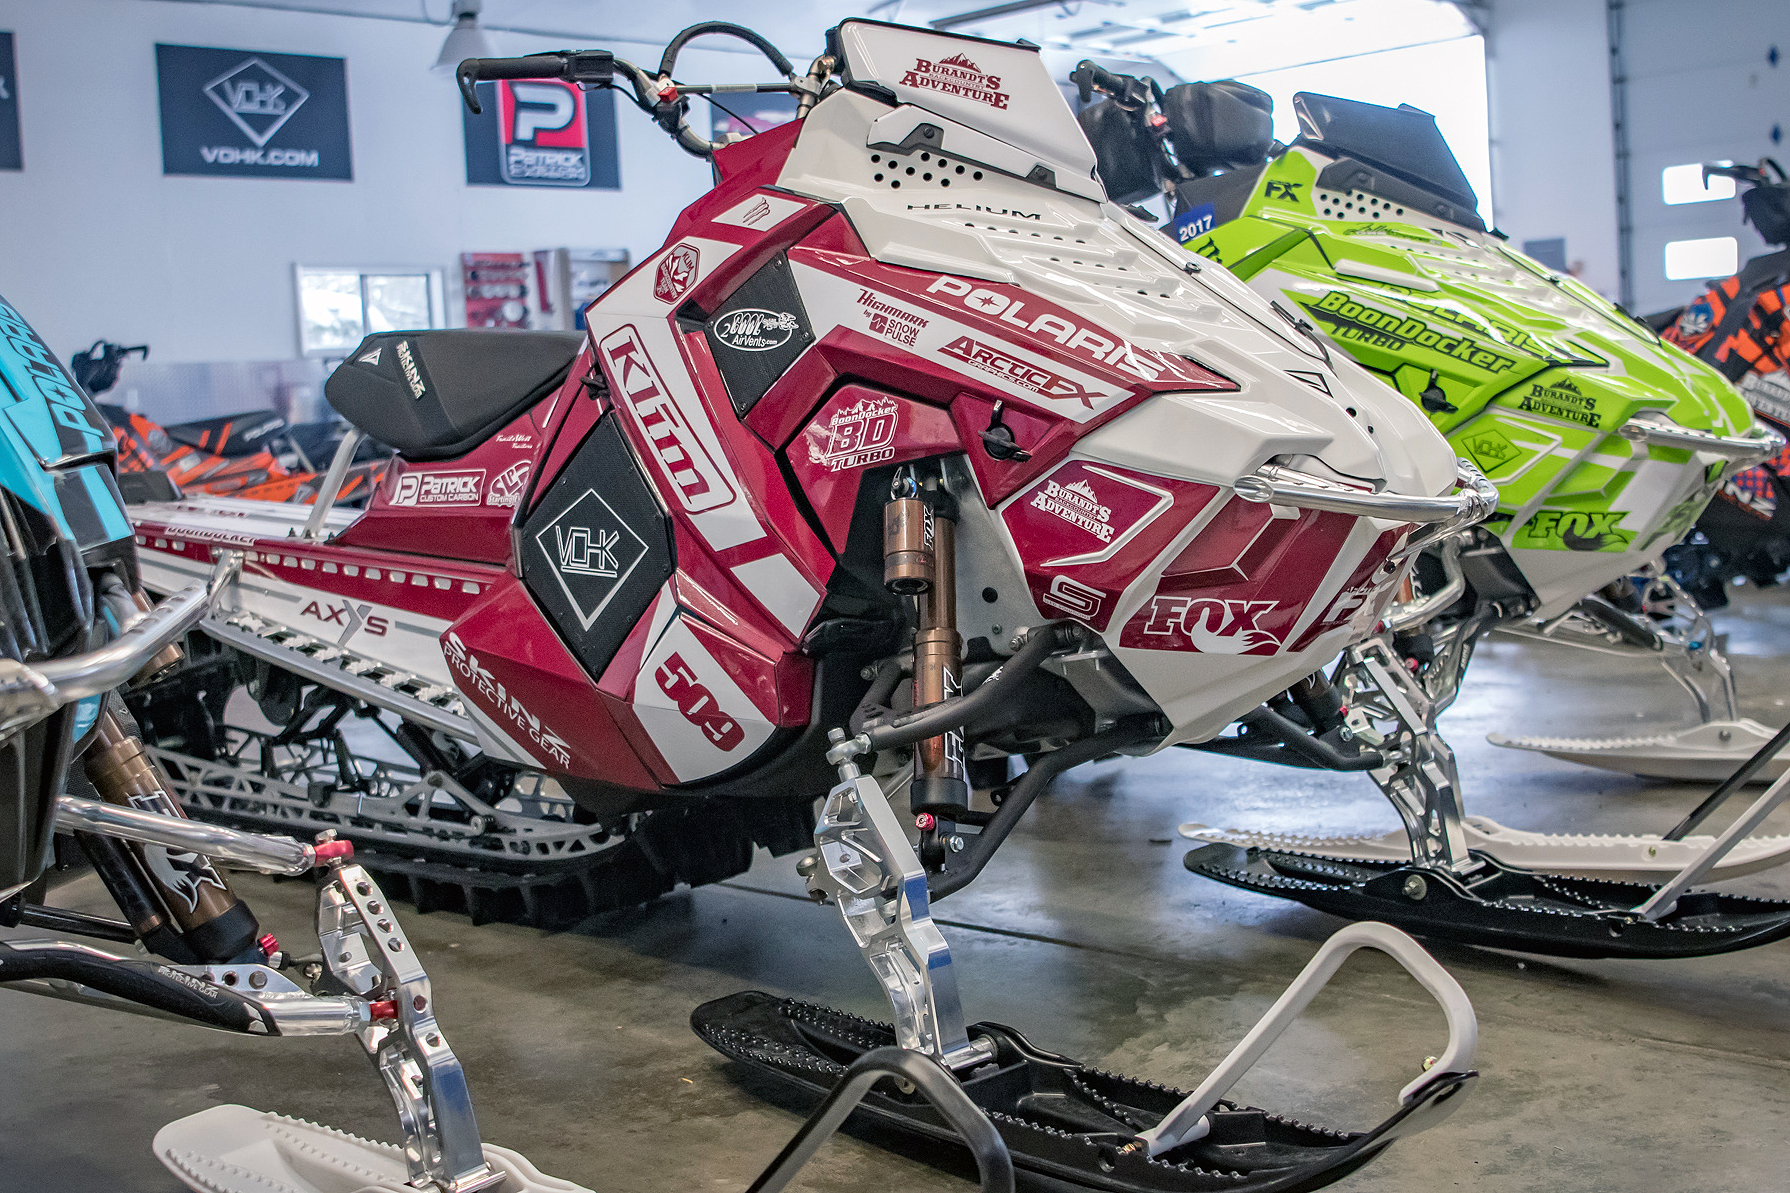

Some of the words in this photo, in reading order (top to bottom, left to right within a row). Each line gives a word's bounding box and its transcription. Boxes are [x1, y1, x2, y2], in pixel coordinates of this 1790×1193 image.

[899, 70, 1010, 110] ADVENTURE
[913, 58, 1001, 90] BURANDT'S
[200, 147, 320, 167] VOHK.COM
[1264, 180, 1303, 203] FX
[907, 204, 1041, 220] HELIUM
[1179, 215, 1213, 242] 2017
[682, 251, 694, 269] KLIM
[885, 328, 917, 347] PULSE
[926, 275, 1166, 381] POLARIS
[1330, 324, 1406, 352] TURBO
[396, 340, 426, 391] SKINZ
[1518, 395, 1602, 428] ADVENTURE
[1530, 383, 1597, 411] BURANDT'S
[831, 447, 895, 472] TURBO
[420, 494, 448, 503] CUSTOM
[448, 493, 479, 502] CARBON
[1044, 479, 1112, 523] BURANDT'S
[1030, 491, 1115, 544] ADVENTURE
[1527, 510, 1630, 544] FOX
[300, 599, 389, 648] AXYS
[1143, 596, 1280, 642] FOX
[443, 641, 526, 731] PROTECTIVE
[529, 728, 571, 770] GEAR
[448, 632, 571, 759] SKINZ
[655, 651, 745, 752] 509
